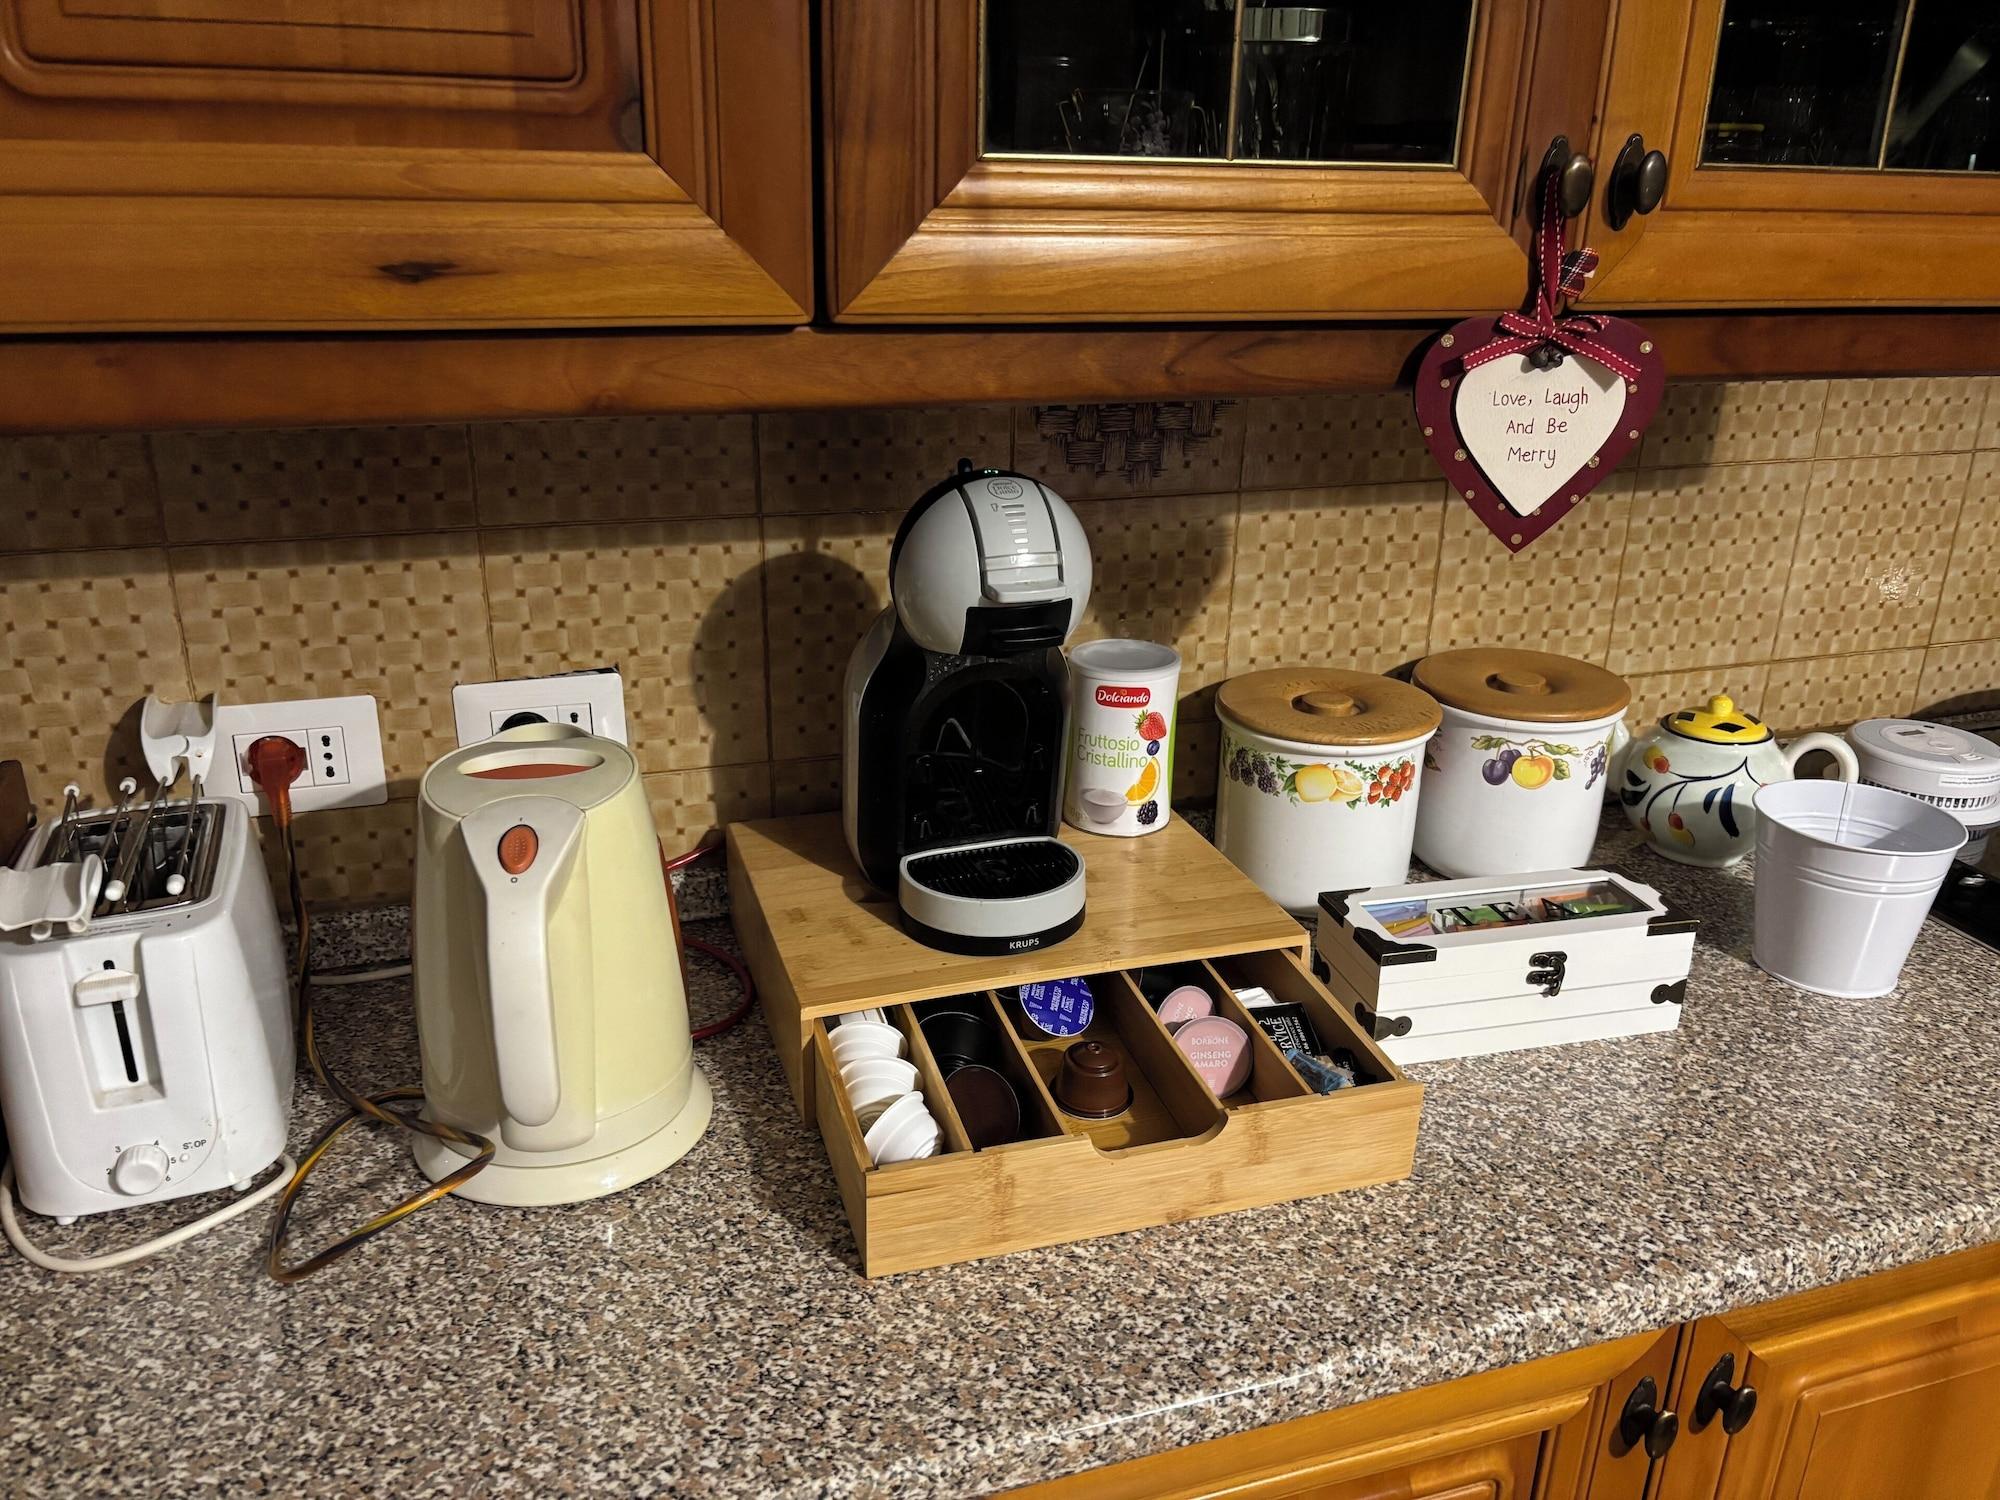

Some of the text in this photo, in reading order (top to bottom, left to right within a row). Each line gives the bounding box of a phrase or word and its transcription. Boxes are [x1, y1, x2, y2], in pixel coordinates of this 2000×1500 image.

[1493, 387, 1588, 414] Love, Laugh
[1506, 418, 1568, 434] And Be
[1508, 447, 1556, 469] Merry
[1097, 689, 1149, 704] Dolciando
[1078, 727, 1140, 751] Fruttosio
[1077, 744, 1148, 769] Cristallino
[1435, 898, 1584, 927] TEA
[1009, 938, 1040, 950] KRUPS
[1191, 1036, 1229, 1046] BORBONE
[1190, 1051, 1232, 1060] GINSENG
[1193, 1059, 1229, 1069] AMARO
